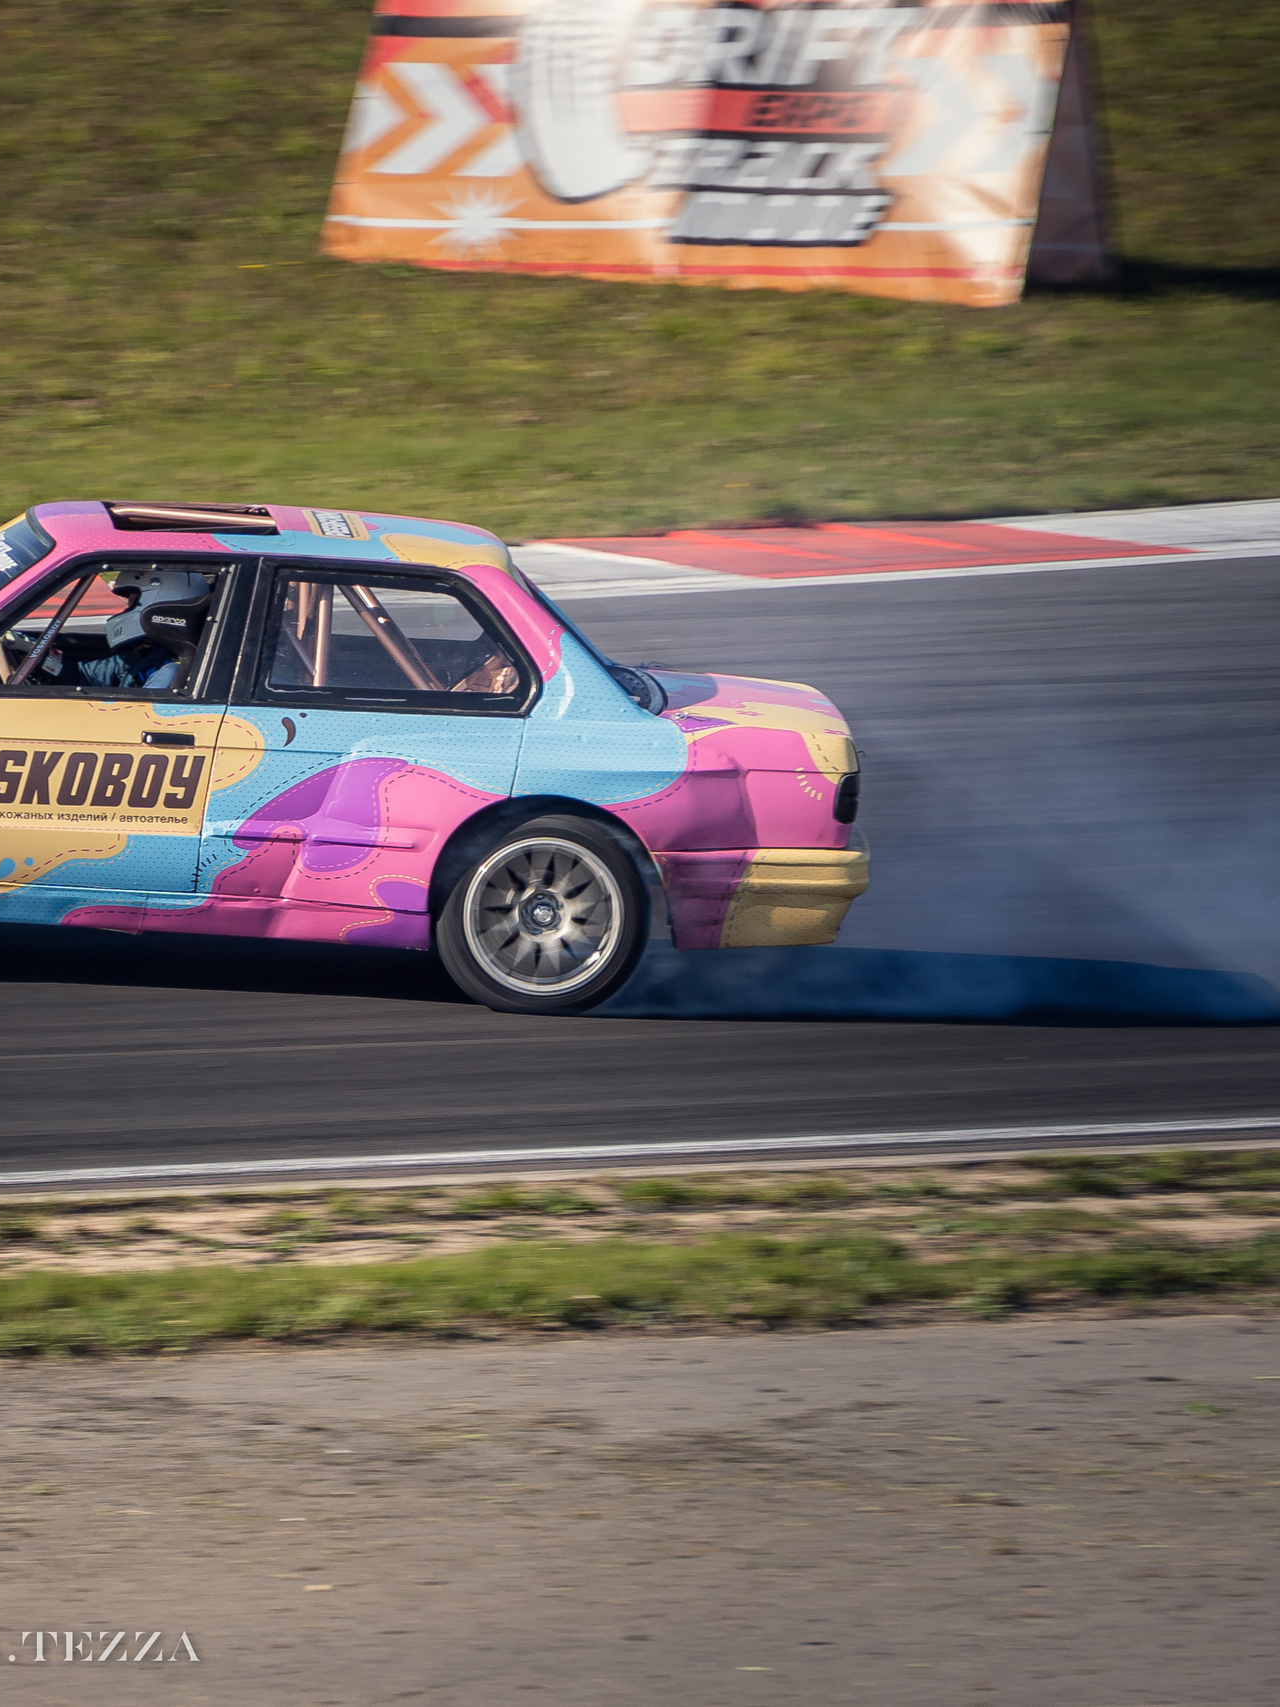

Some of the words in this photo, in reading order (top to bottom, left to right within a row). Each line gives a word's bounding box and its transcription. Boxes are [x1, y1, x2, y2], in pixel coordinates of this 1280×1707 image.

[0, 810, 53, 821] кожаных
[57, 811, 108, 822] изделий
[119, 814, 188, 825] автоателье
